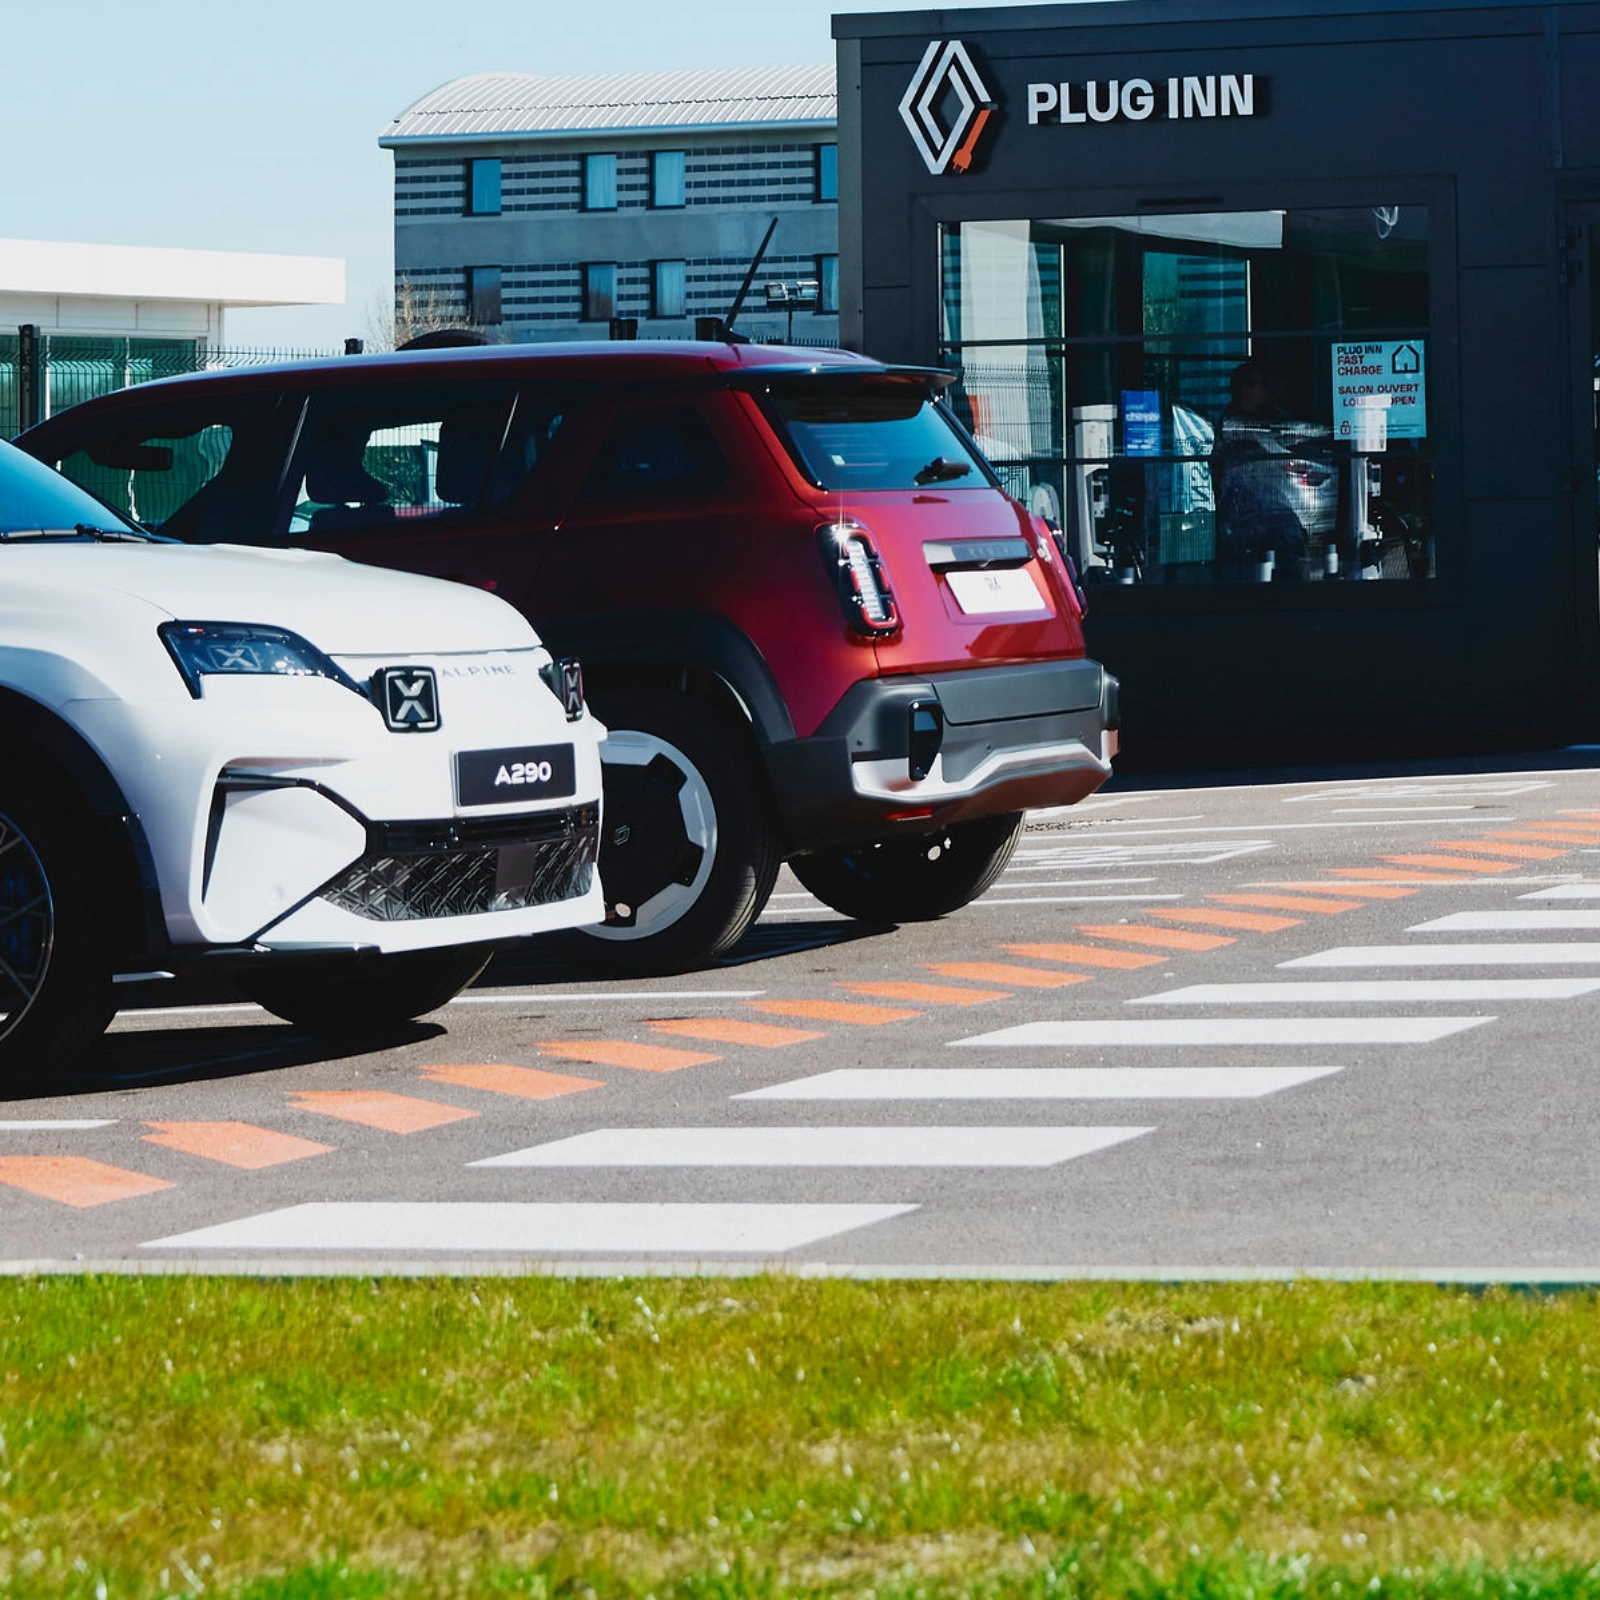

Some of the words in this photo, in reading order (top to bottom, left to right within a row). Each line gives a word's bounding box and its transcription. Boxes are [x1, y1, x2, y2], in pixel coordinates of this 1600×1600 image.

[1027, 78, 1155, 125] PLUG
[1167, 74, 1254, 119] INN
[1337, 345, 1362, 355] PLUG
[1364, 344, 1382, 354] INN
[1337, 355, 1364, 365] FAST
[1337, 365, 1383, 376] CHARGE
[1338, 385, 1373, 395] SALON
[1377, 384, 1419, 394] OUVERT
[442, 665, 517, 677] ALPINE
[494, 760, 552, 786] A290
